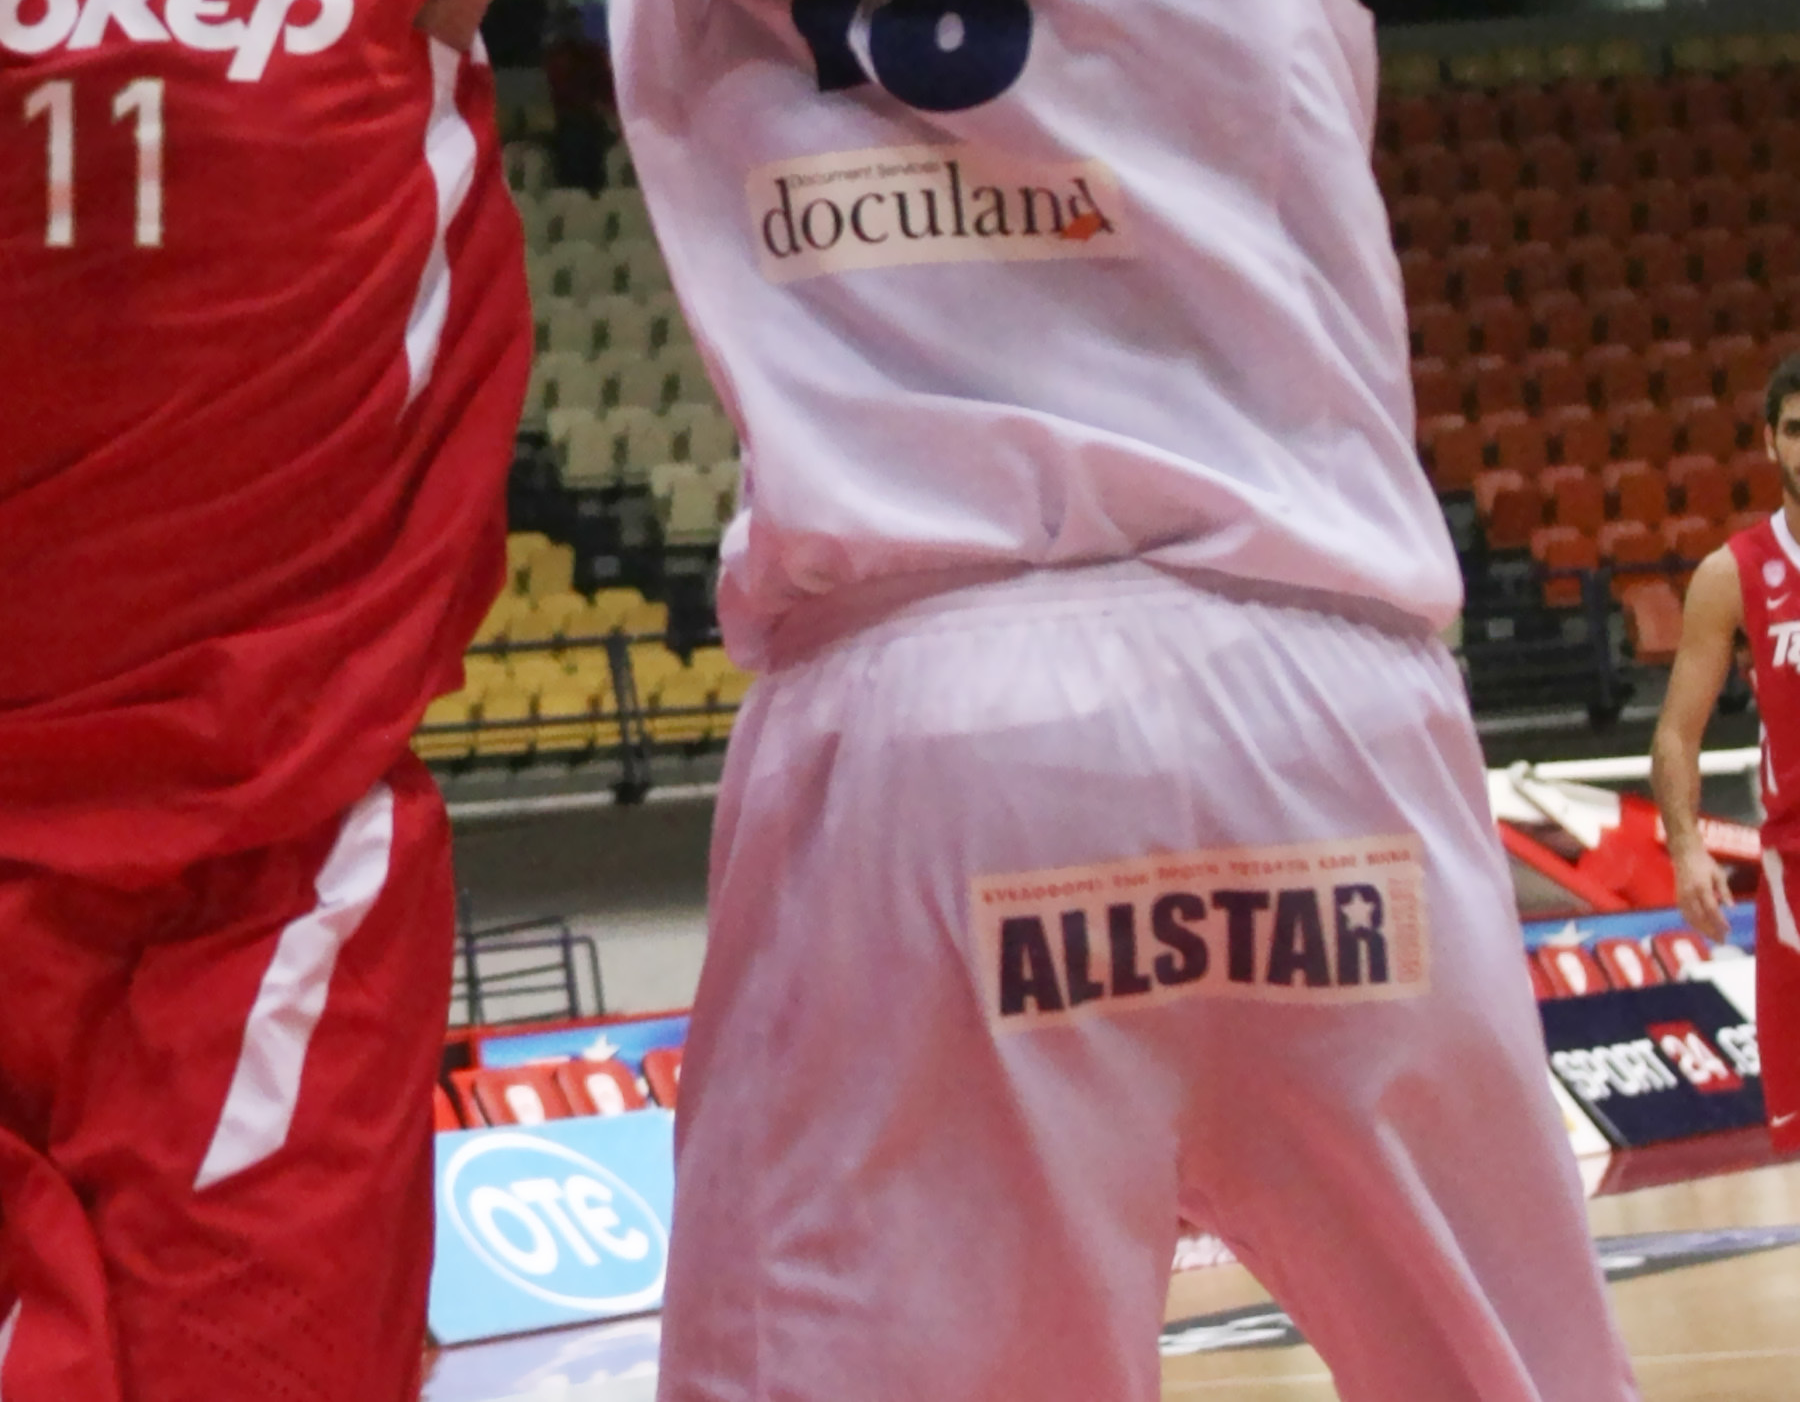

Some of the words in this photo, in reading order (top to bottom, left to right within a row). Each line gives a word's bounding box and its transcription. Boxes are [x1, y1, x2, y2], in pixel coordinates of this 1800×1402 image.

[22, 79, 165, 248] 11
[762, 160, 1115, 258] doculand
[999, 882, 1390, 1017] ALLSTAR
[1552, 1037, 1679, 1100] SPORT
[1659, 1031, 1731, 1085] 24
[468, 1174, 650, 1276] OTE
